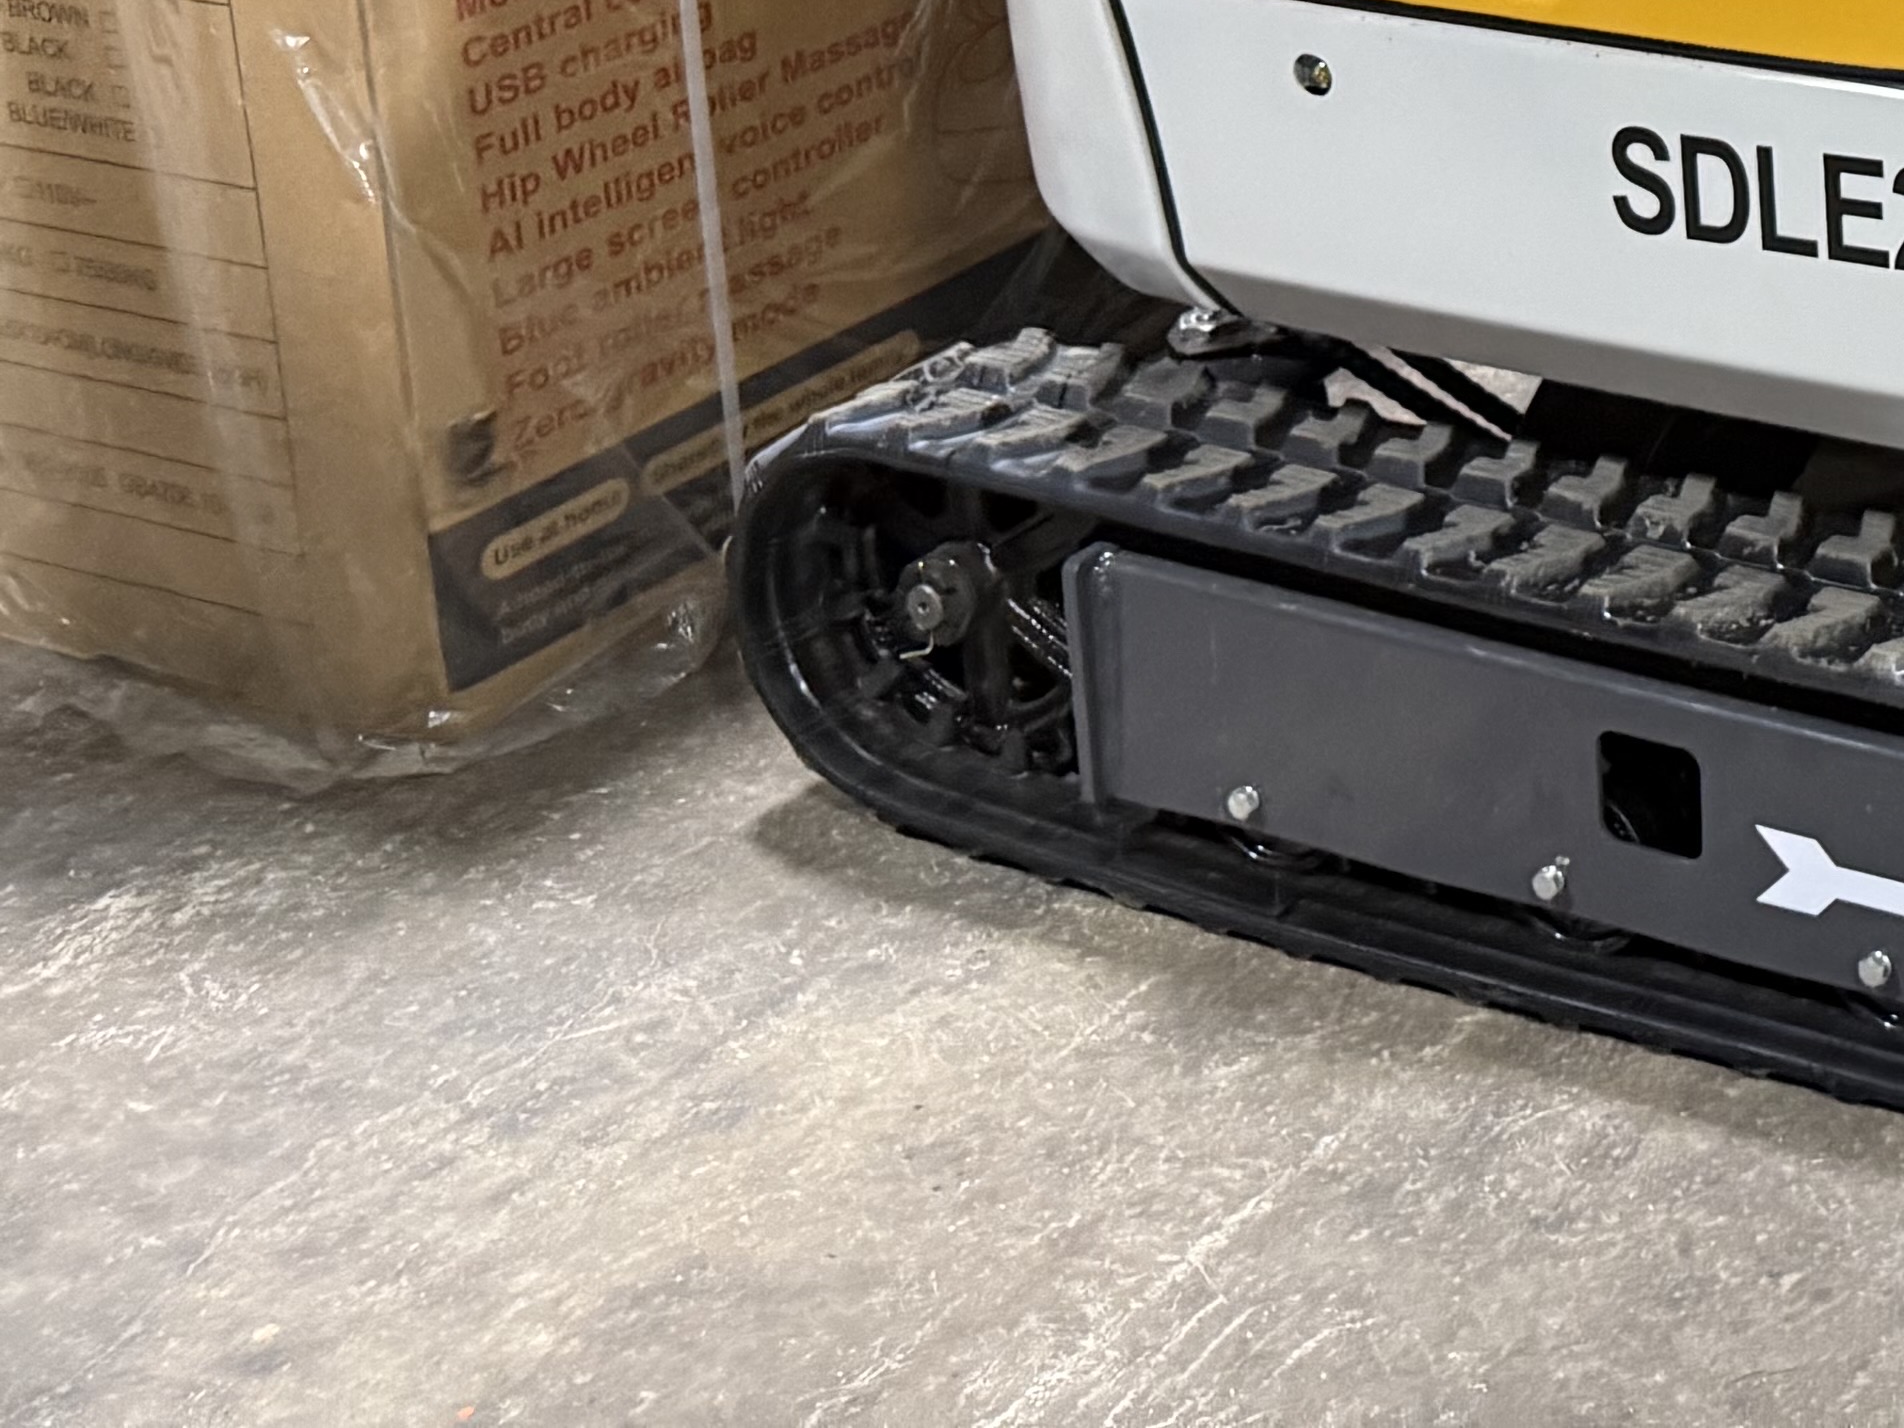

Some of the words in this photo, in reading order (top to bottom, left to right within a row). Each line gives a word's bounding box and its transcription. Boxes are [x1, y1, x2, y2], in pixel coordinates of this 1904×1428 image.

[468, 61, 547, 116] USB
[474, 112, 542, 168] Full
[554, 79, 640, 133] body
[481, 171, 541, 214] Hip
[552, 112, 660, 182] Wheel
[536, 152, 696, 240] intelligen
[719, 104, 806, 154] voice
[817, 53, 918, 114] contro
[607, 199, 699, 258] scree
[732, 116, 883, 200] controller
